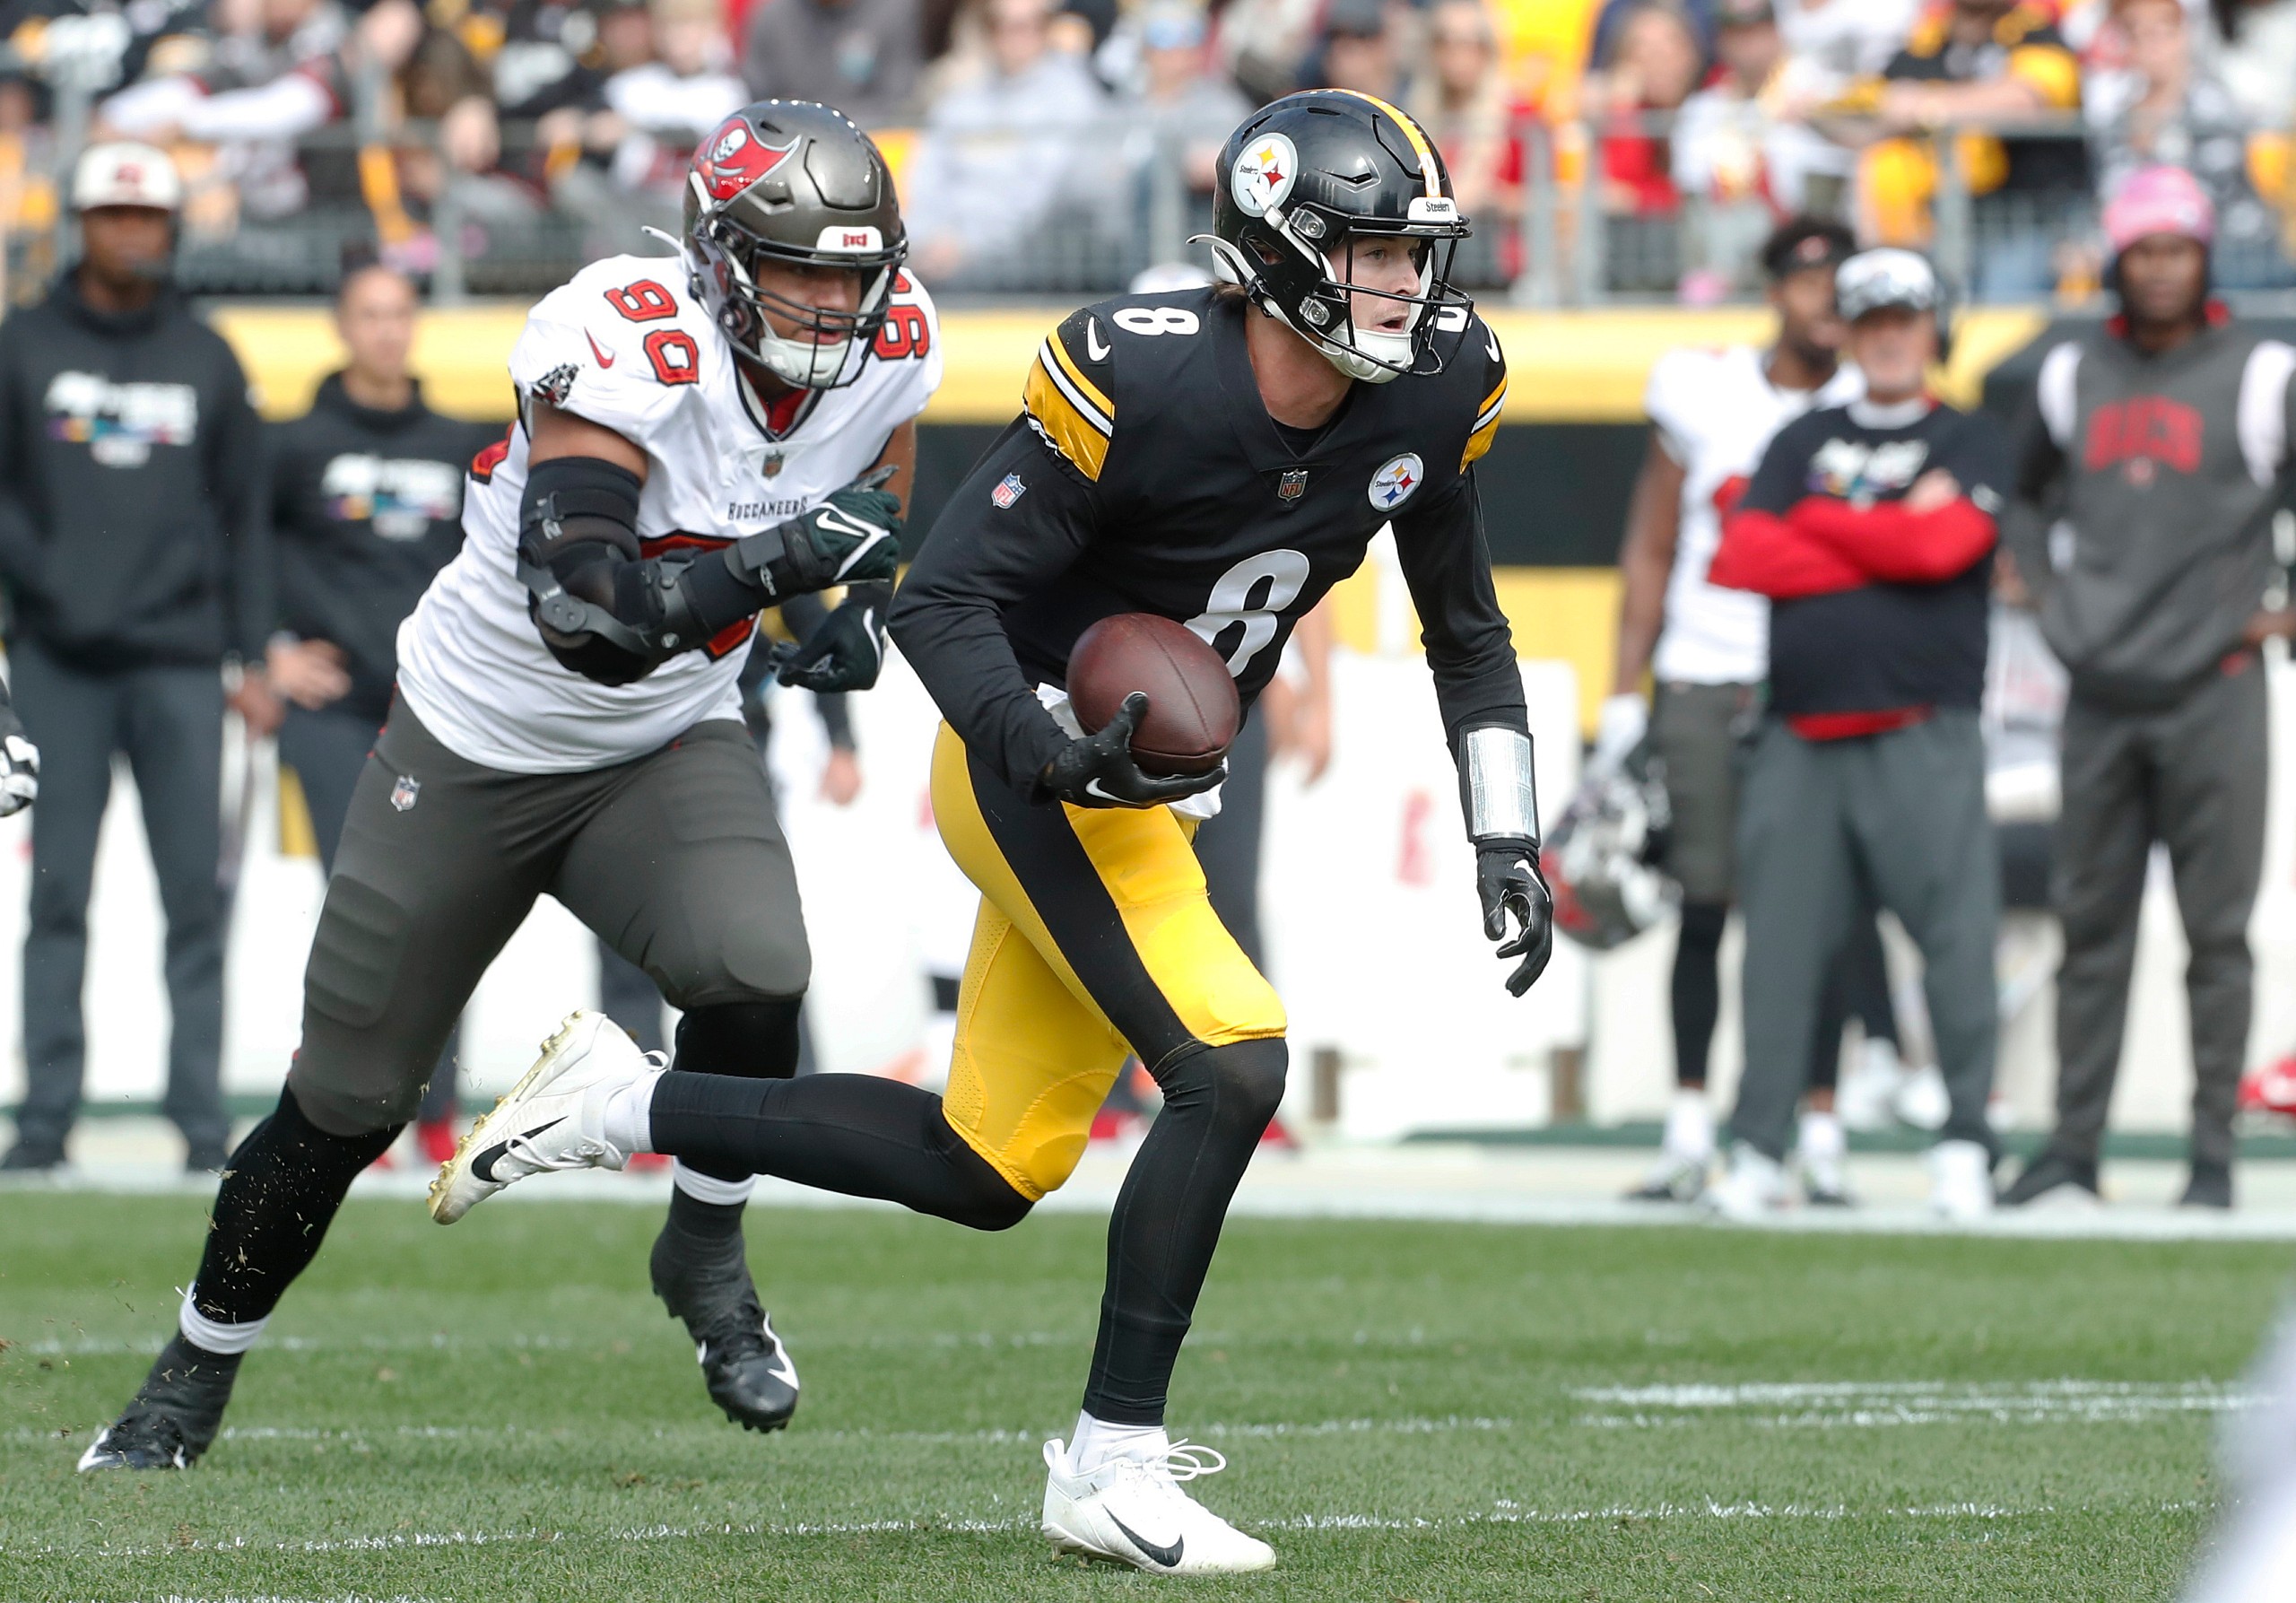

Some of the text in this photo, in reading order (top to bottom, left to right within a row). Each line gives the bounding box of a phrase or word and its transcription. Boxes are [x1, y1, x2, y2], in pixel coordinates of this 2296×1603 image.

[1418, 152, 1440, 196] 8
[1425, 200, 1450, 213] Steelers
[873, 272, 930, 362] 9
[1112, 307, 1200, 336] 8
[603, 278, 700, 388] 90
[1283, 484, 1301, 495] NFL
[1374, 480, 1396, 488] Steelers
[727, 495, 808, 521] BUCCANEERS
[1183, 548, 1310, 679] 8
